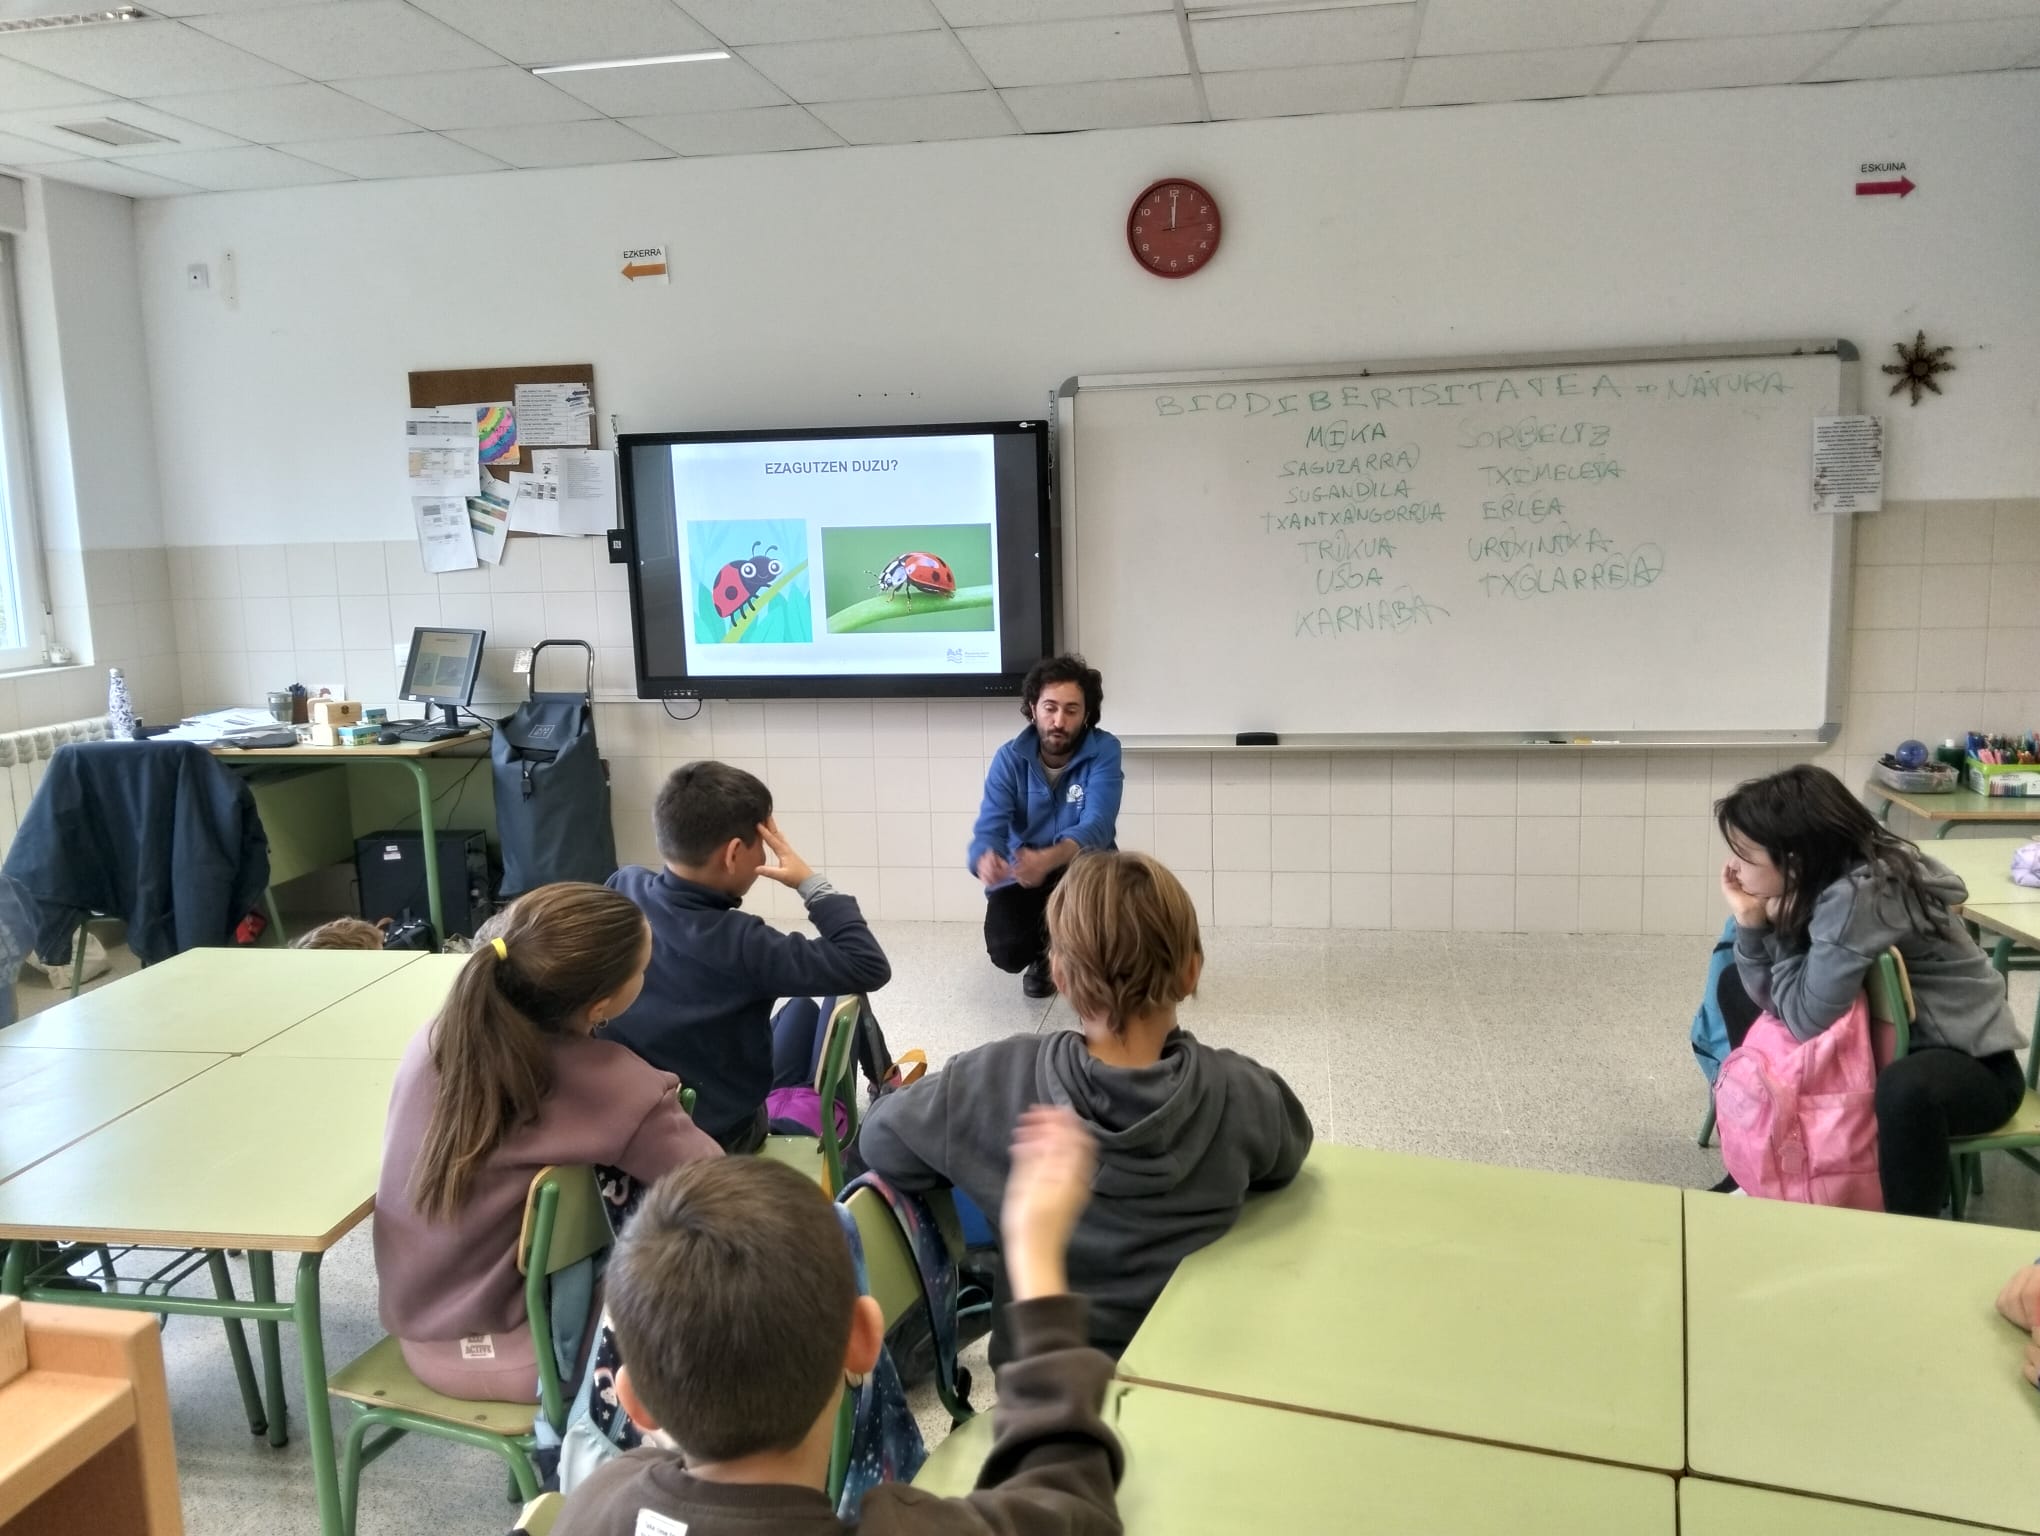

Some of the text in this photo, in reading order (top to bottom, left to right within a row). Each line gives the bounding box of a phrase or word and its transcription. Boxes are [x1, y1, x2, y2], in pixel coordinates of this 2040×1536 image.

[1861, 162, 1907, 173] ESKUINA
[1141, 208, 1151, 216] 10
[1200, 206, 1207, 214] 2
[1135, 226, 1142, 234] 9
[1206, 223, 1213, 231] 3
[1142, 243, 1149, 251] 8
[1200, 241, 1207, 249] 4
[623, 248, 662, 259] EZKERRA
[1187, 255, 1194, 263] 5
[1153, 256, 1160, 264] 7
[1170, 260, 1177, 268] 6
[1155, 374, 1623, 418] BIODIBERTSITATEA
[1306, 421, 1387, 449] MIKA
[765, 459, 899, 475] EZAGUTZEN DUZU?
[1279, 450, 1417, 478] SAGUZARRA
[1285, 479, 1415, 504] SUGANDILA
[1482, 497, 1565, 521] ERLEA
[1260, 502, 1447, 534] TXANTXANGORRIA
[1297, 533, 1397, 563] TRIKUA
[1317, 567, 1383, 594] USOA
[1479, 554, 1664, 599] TXOLARREA
